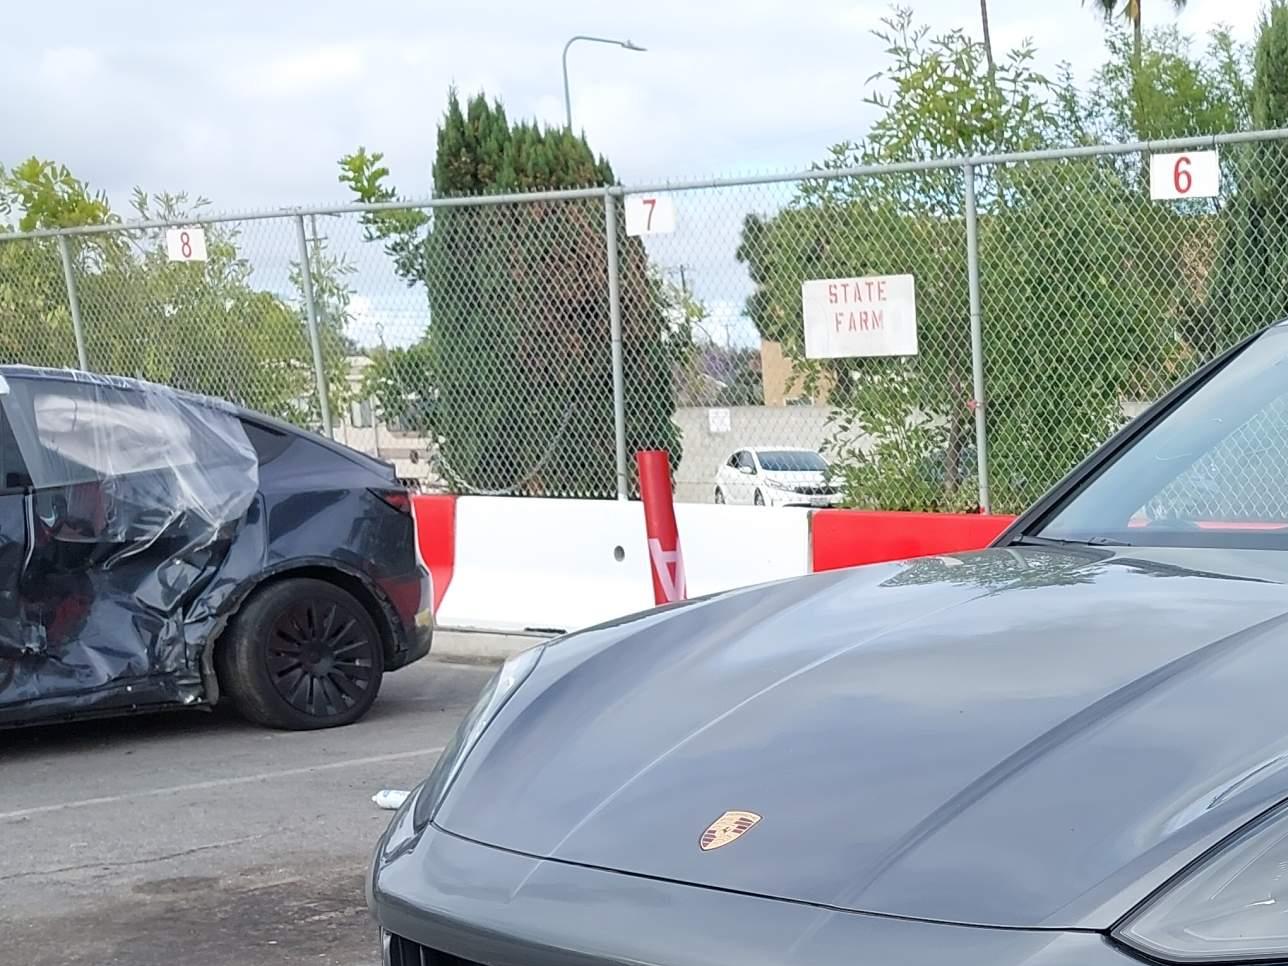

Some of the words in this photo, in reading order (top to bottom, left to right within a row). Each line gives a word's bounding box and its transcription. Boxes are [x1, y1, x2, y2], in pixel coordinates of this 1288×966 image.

[1173, 156, 1193, 194] 6
[642, 198, 657, 231] 7
[180, 231, 192, 258] 8
[828, 280, 887, 304] STATE
[835, 310, 884, 333] FARM
